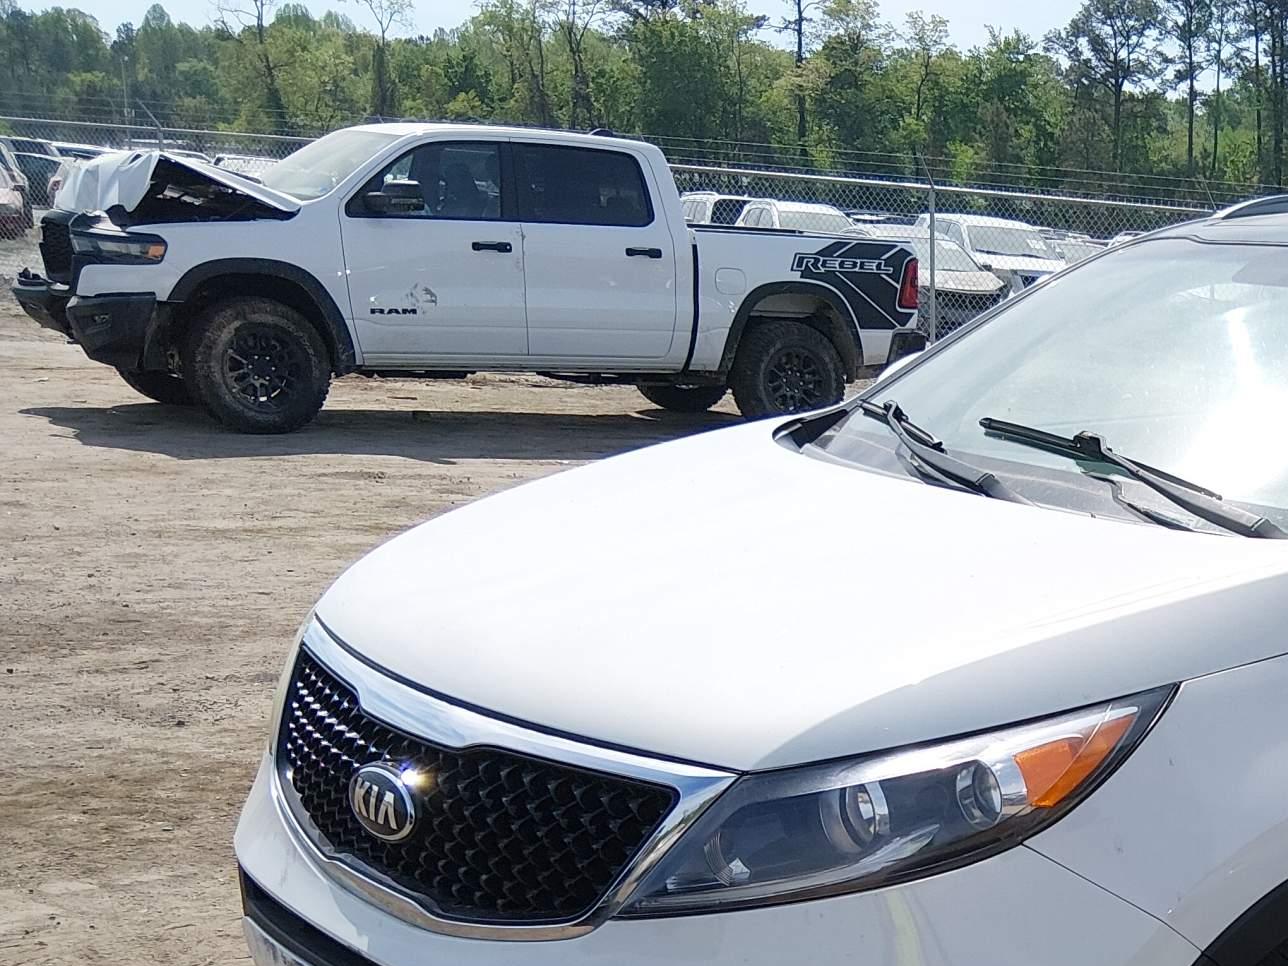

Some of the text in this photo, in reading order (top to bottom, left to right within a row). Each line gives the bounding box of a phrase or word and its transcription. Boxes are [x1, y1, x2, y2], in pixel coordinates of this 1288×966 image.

[791, 253, 894, 274] REBEL
[370, 307, 418, 315] RAM
[354, 776, 398, 830] KIA
